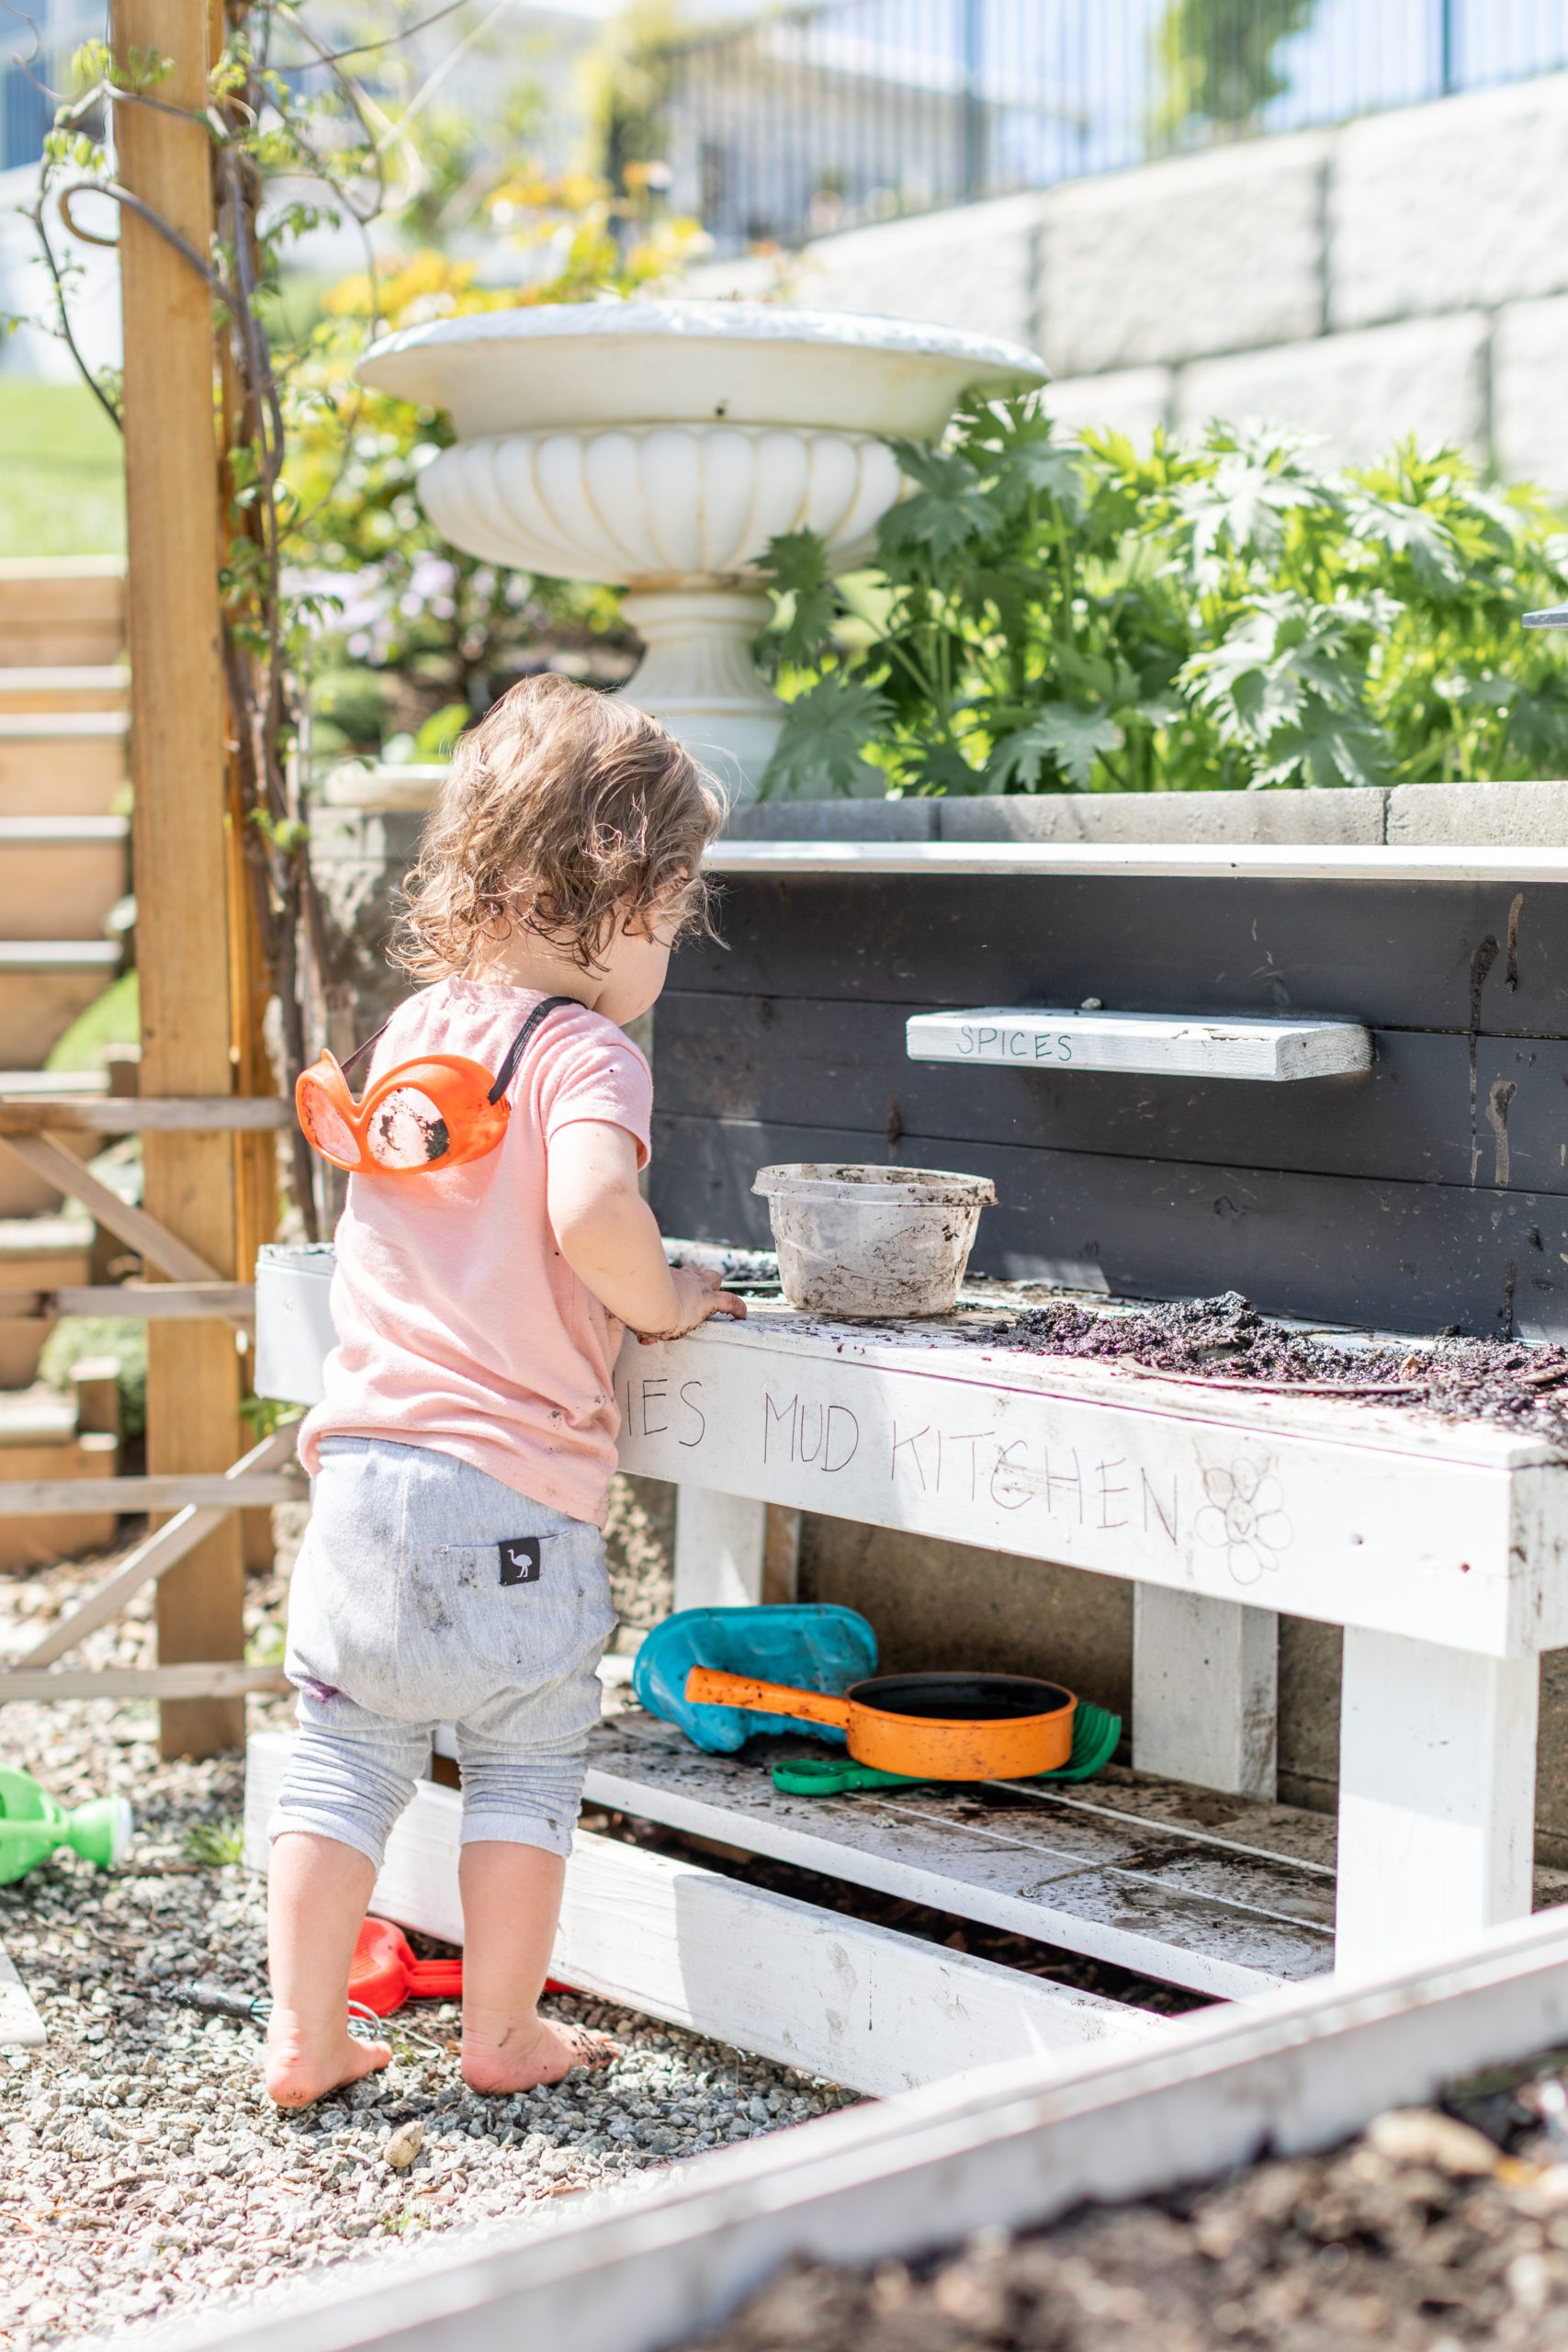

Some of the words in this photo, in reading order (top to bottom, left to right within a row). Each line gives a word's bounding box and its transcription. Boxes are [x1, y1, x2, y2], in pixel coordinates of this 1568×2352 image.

[956, 1024, 1072, 1061] SPICES
[613, 1370, 705, 1447] IES
[763, 1392, 859, 1472] MUD
[891, 1419, 1179, 1545] KITCHEN
